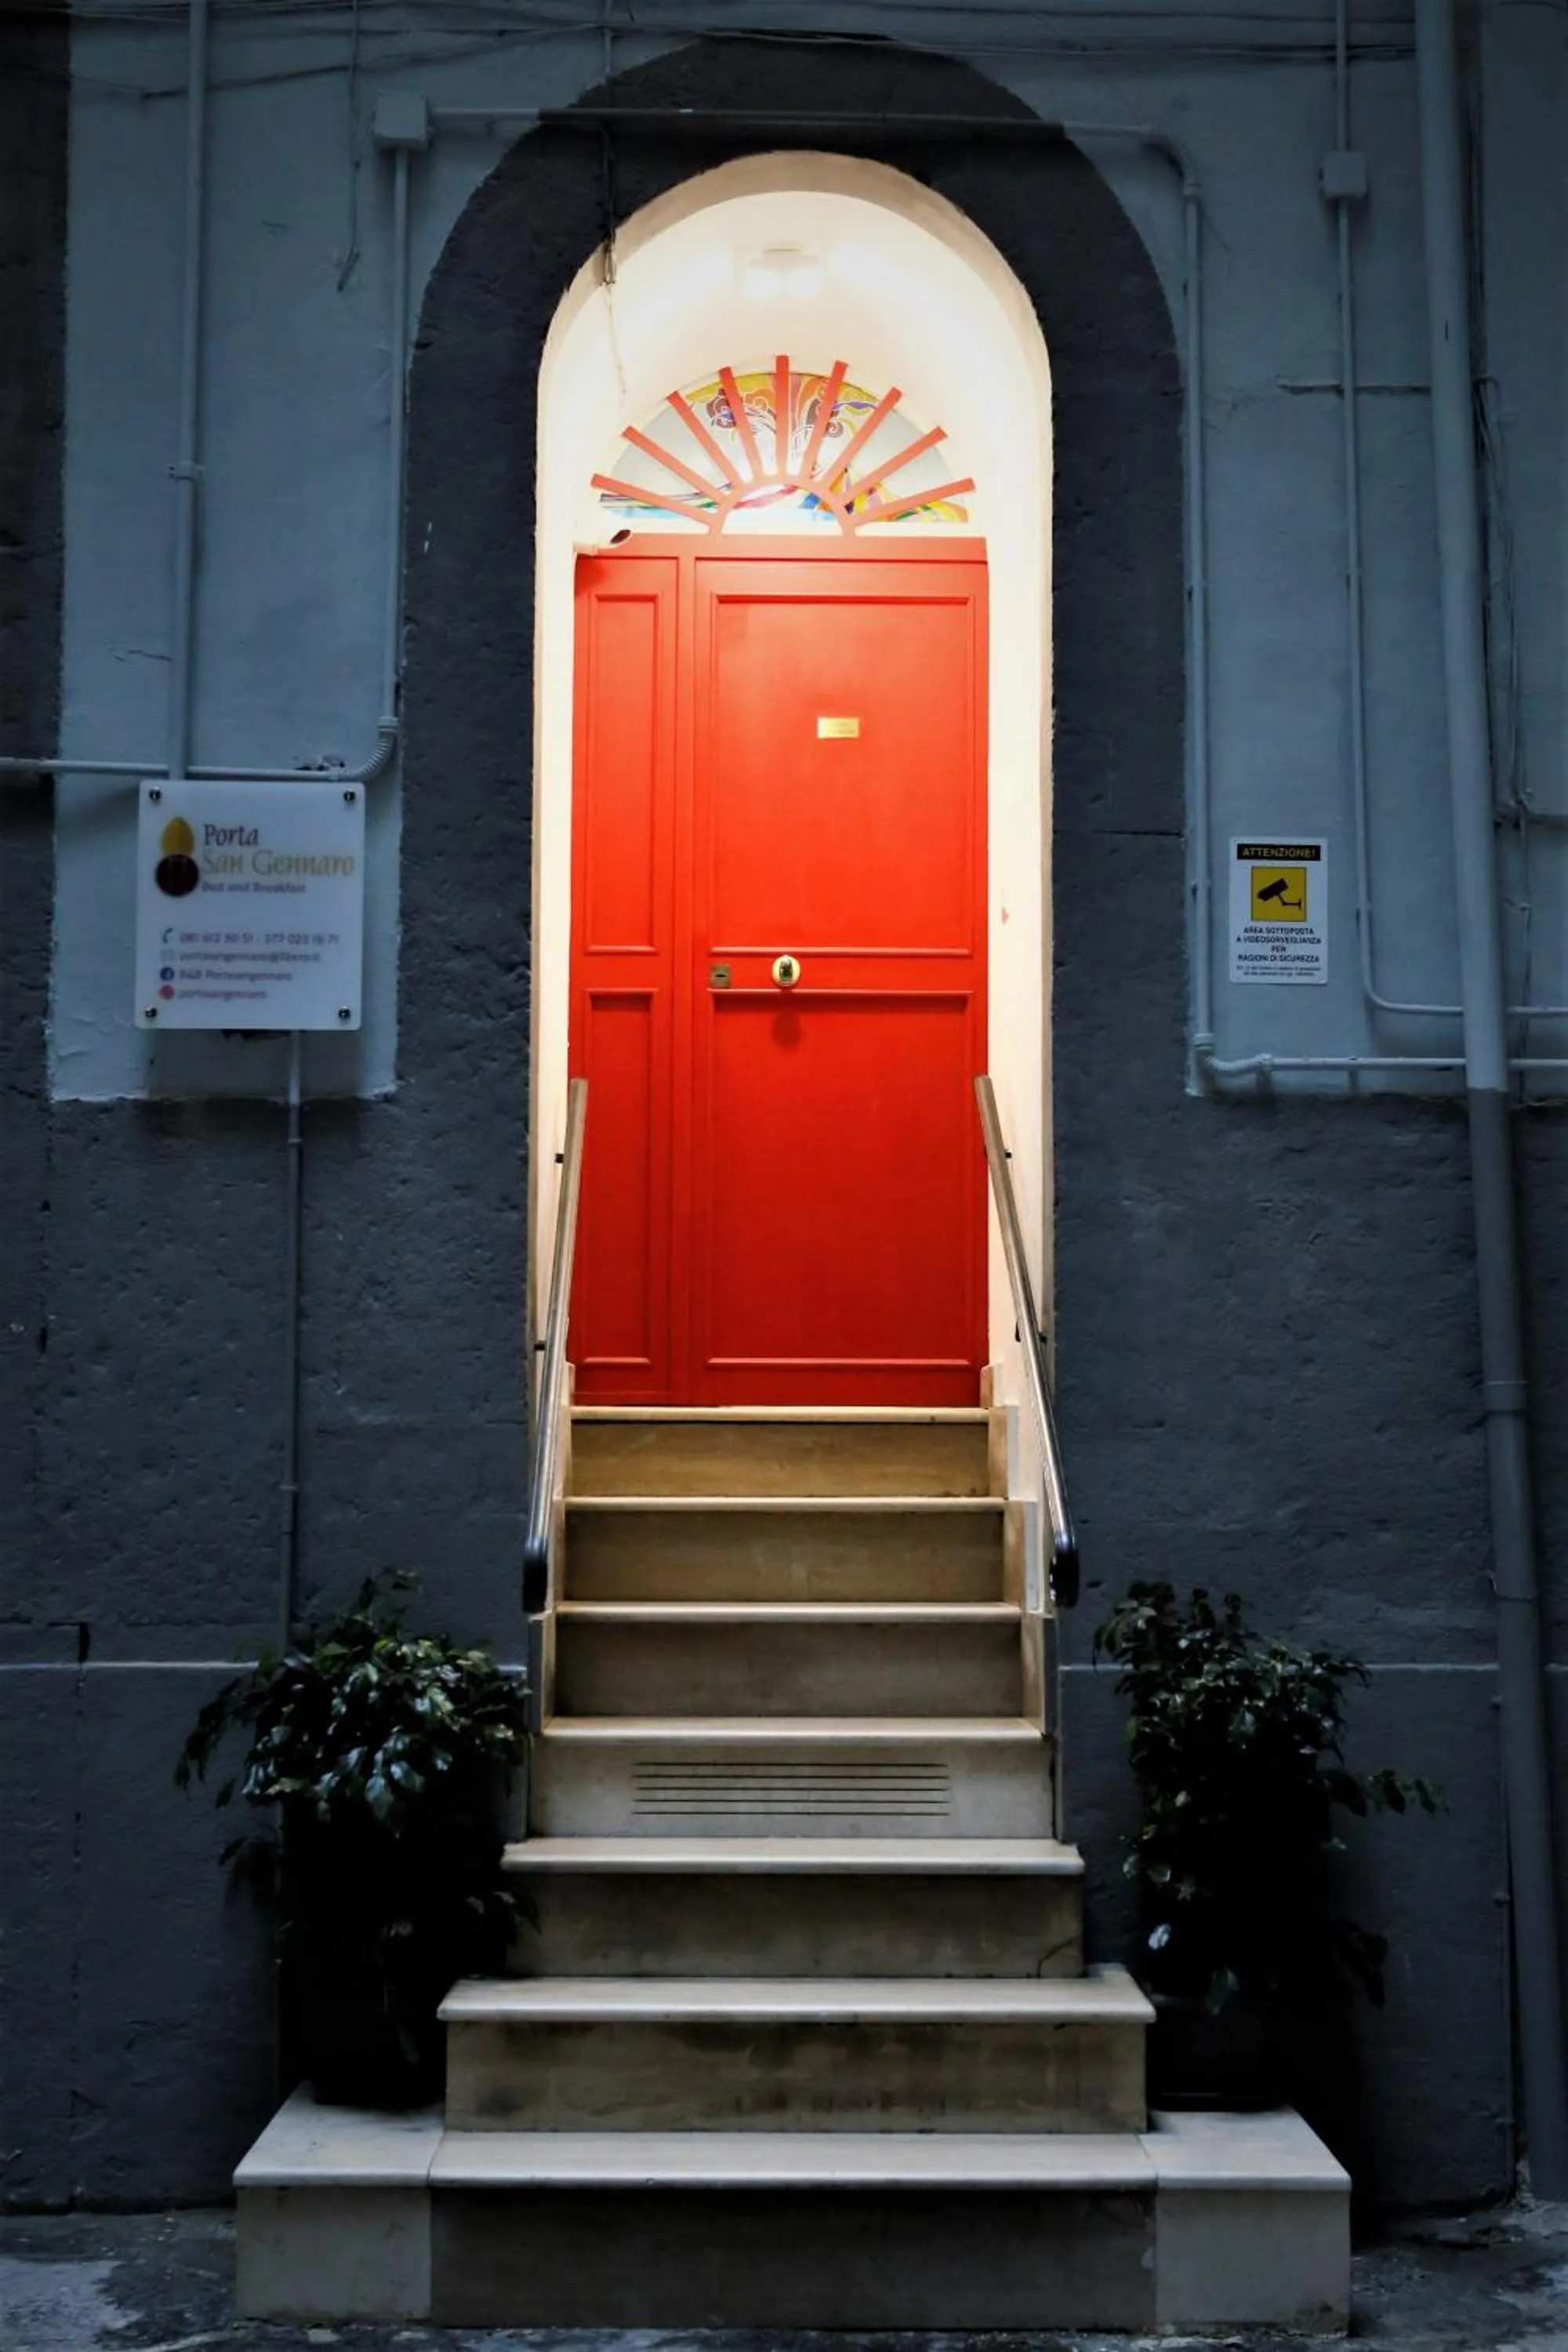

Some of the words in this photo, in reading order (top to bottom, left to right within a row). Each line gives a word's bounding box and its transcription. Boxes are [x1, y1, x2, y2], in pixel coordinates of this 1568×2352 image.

[203, 823, 260, 847] Porta
[202, 849, 243, 875] San
[252, 849, 354, 877] Gennaro
[1242, 847, 1316, 858] ATTENZIONE!
